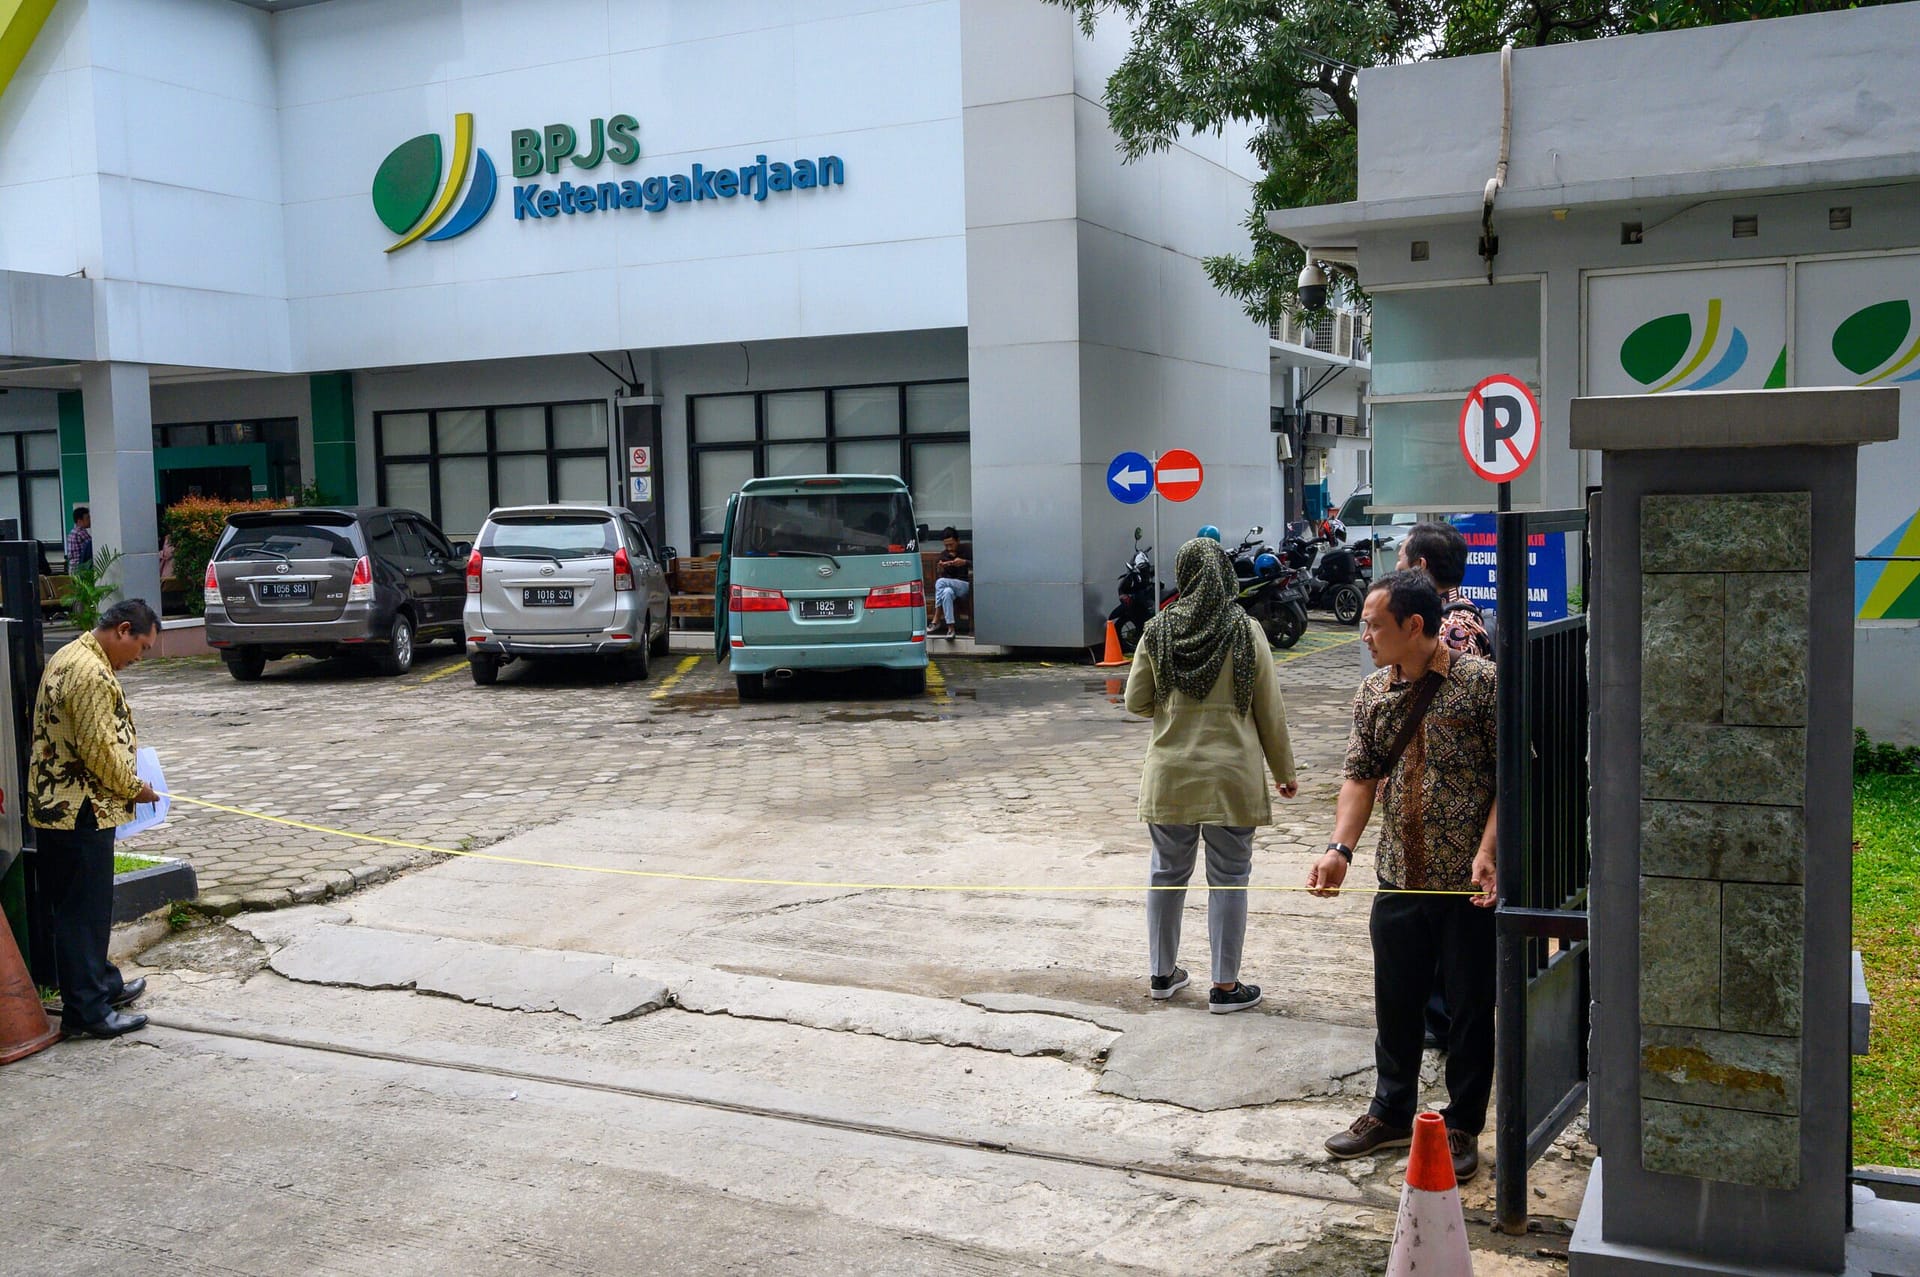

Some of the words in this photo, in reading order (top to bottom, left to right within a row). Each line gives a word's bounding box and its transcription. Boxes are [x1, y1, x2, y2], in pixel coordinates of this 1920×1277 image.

[511, 114, 640, 177] BPJS
[513, 154, 844, 220] Ketenagakerjaan
[1483, 395, 1522, 463] P
[263, 585, 268, 594] B
[273, 584, 290, 593] 1056
[524, 590, 530, 599] B
[537, 590, 555, 599] 1016
[558, 590, 573, 599] SZV
[800, 601, 805, 611] T
[816, 601, 835, 611] 1825
[848, 600, 854, 610] R
